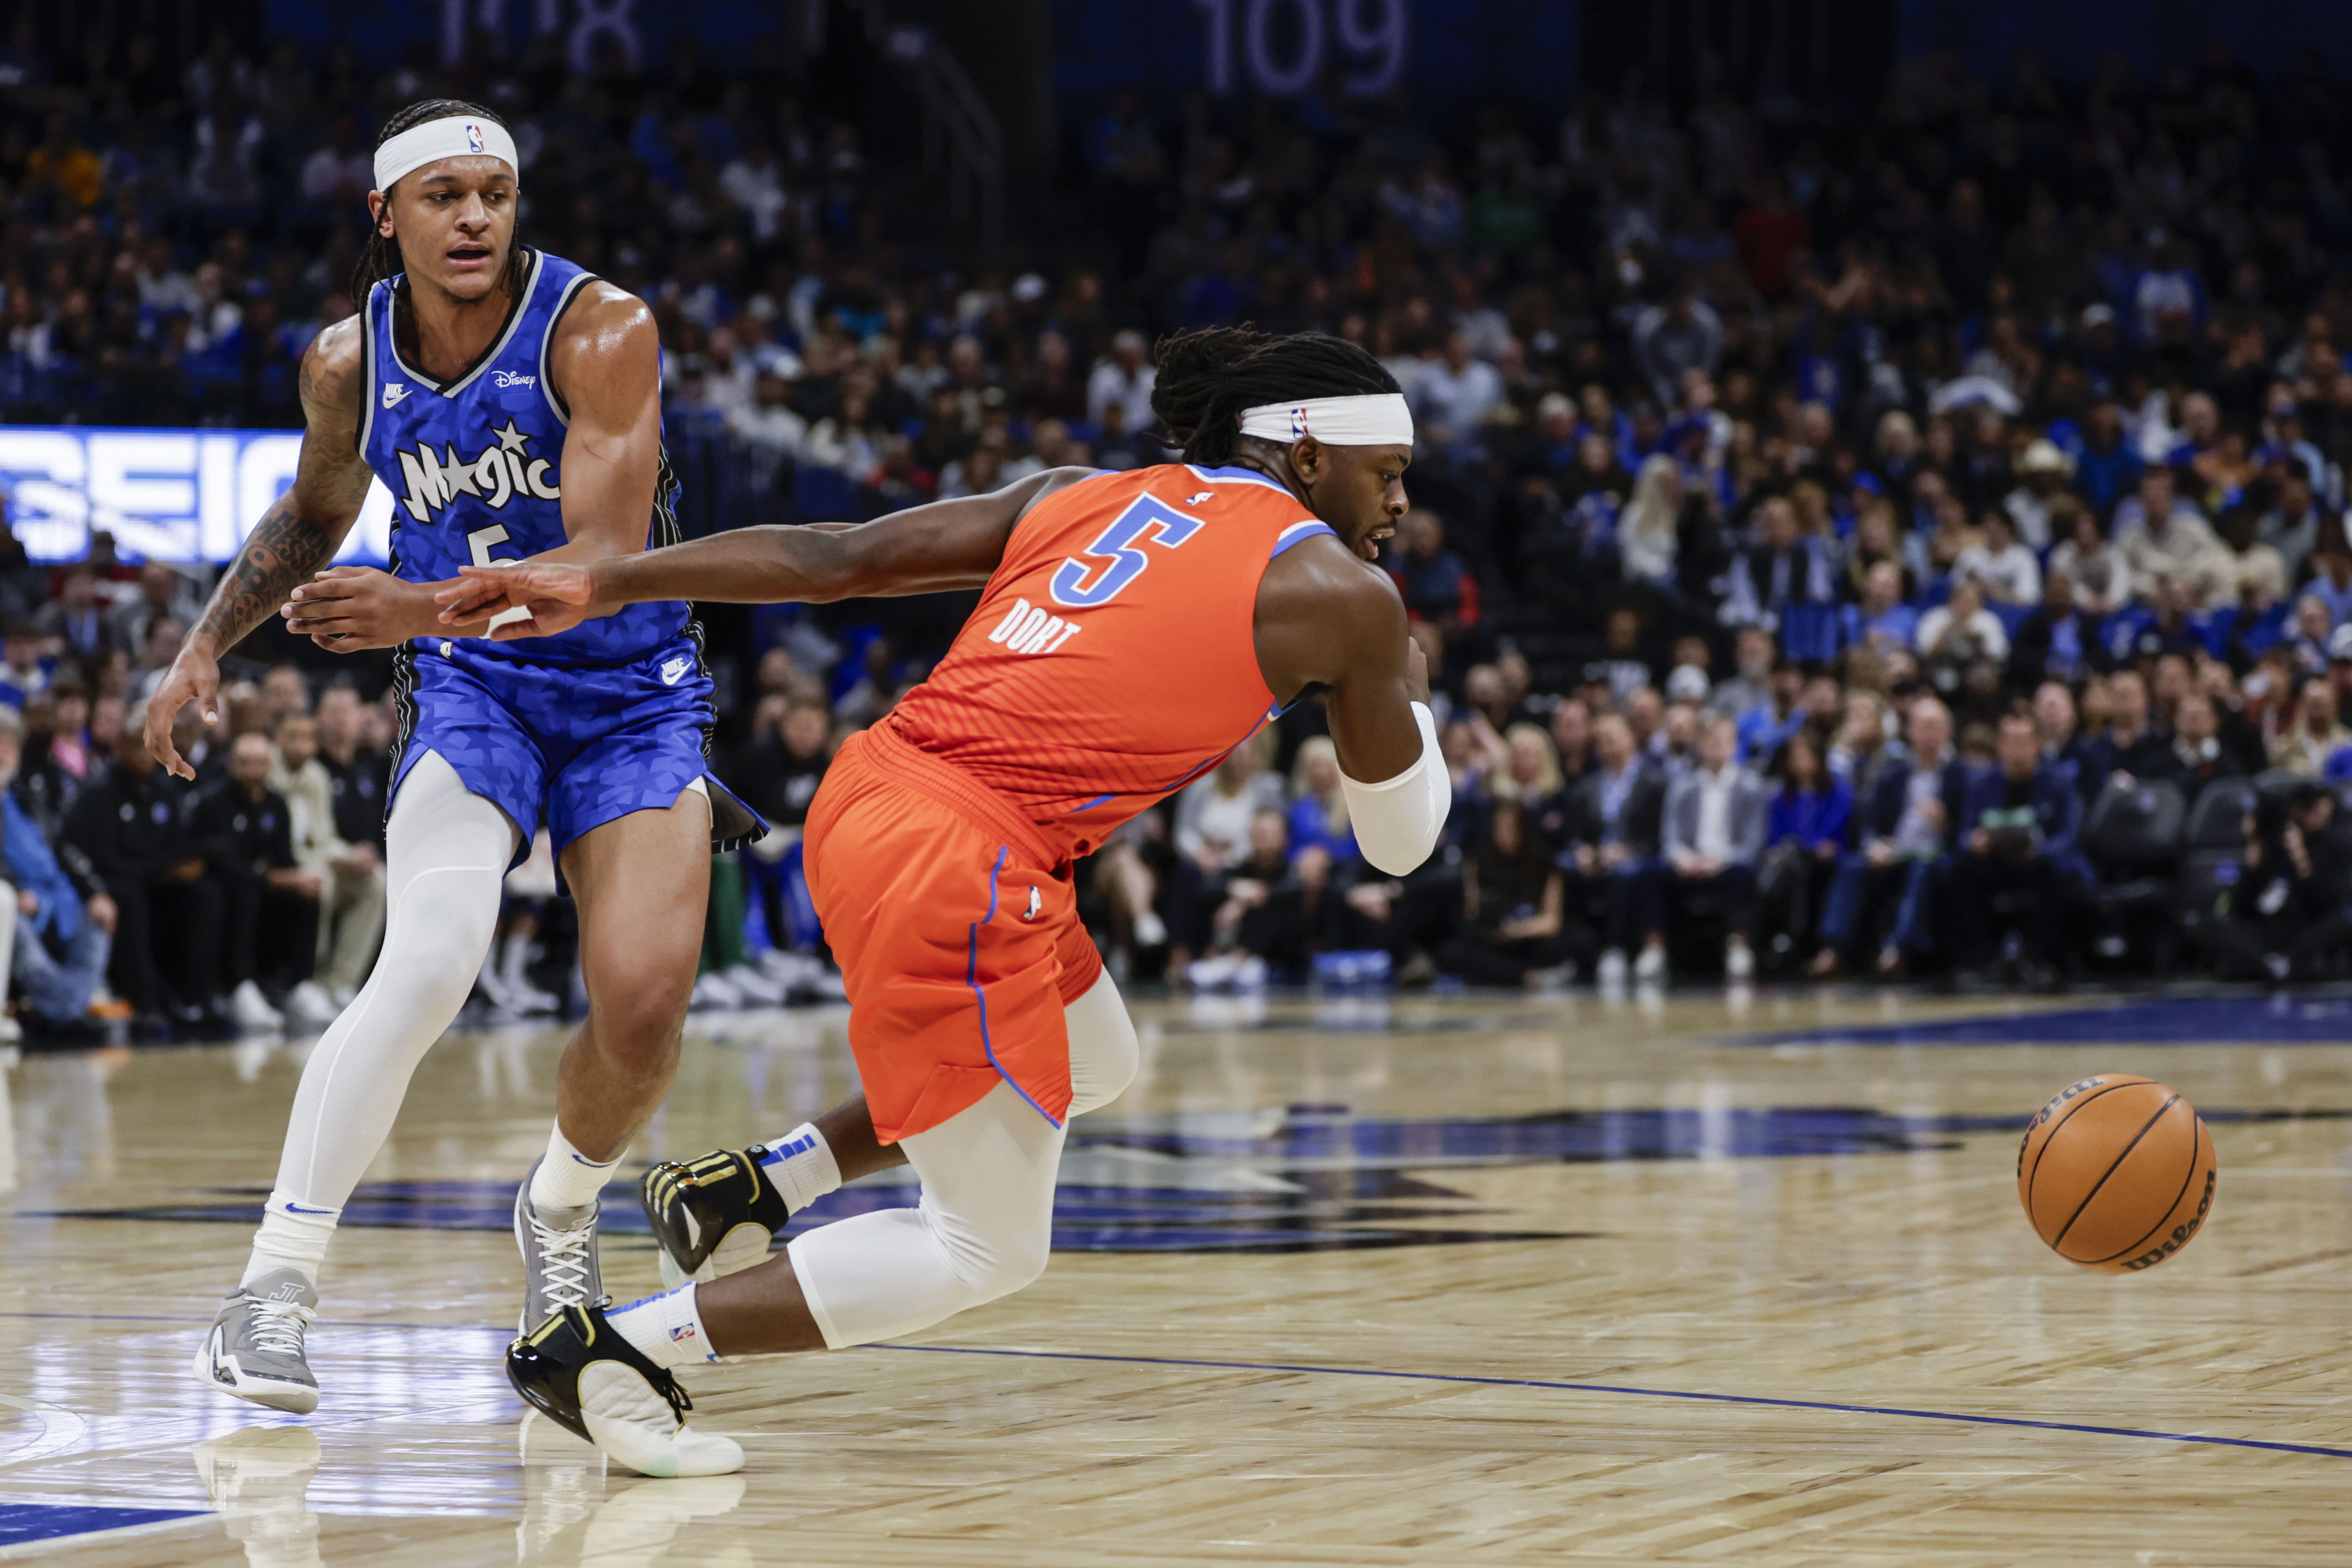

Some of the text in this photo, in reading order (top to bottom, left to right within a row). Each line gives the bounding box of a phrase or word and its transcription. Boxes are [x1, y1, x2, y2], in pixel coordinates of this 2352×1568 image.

[1192, 0, 1407, 95] 109
[385, 383, 404, 398] NIKE
[491, 371, 536, 390] Disney
[396, 416, 561, 525] Magic
[1049, 490, 1206, 608] 5
[988, 597, 1082, 655] DORT
[661, 657, 684, 675] NIKE
[2120, 1169, 2215, 1271] Wilson
